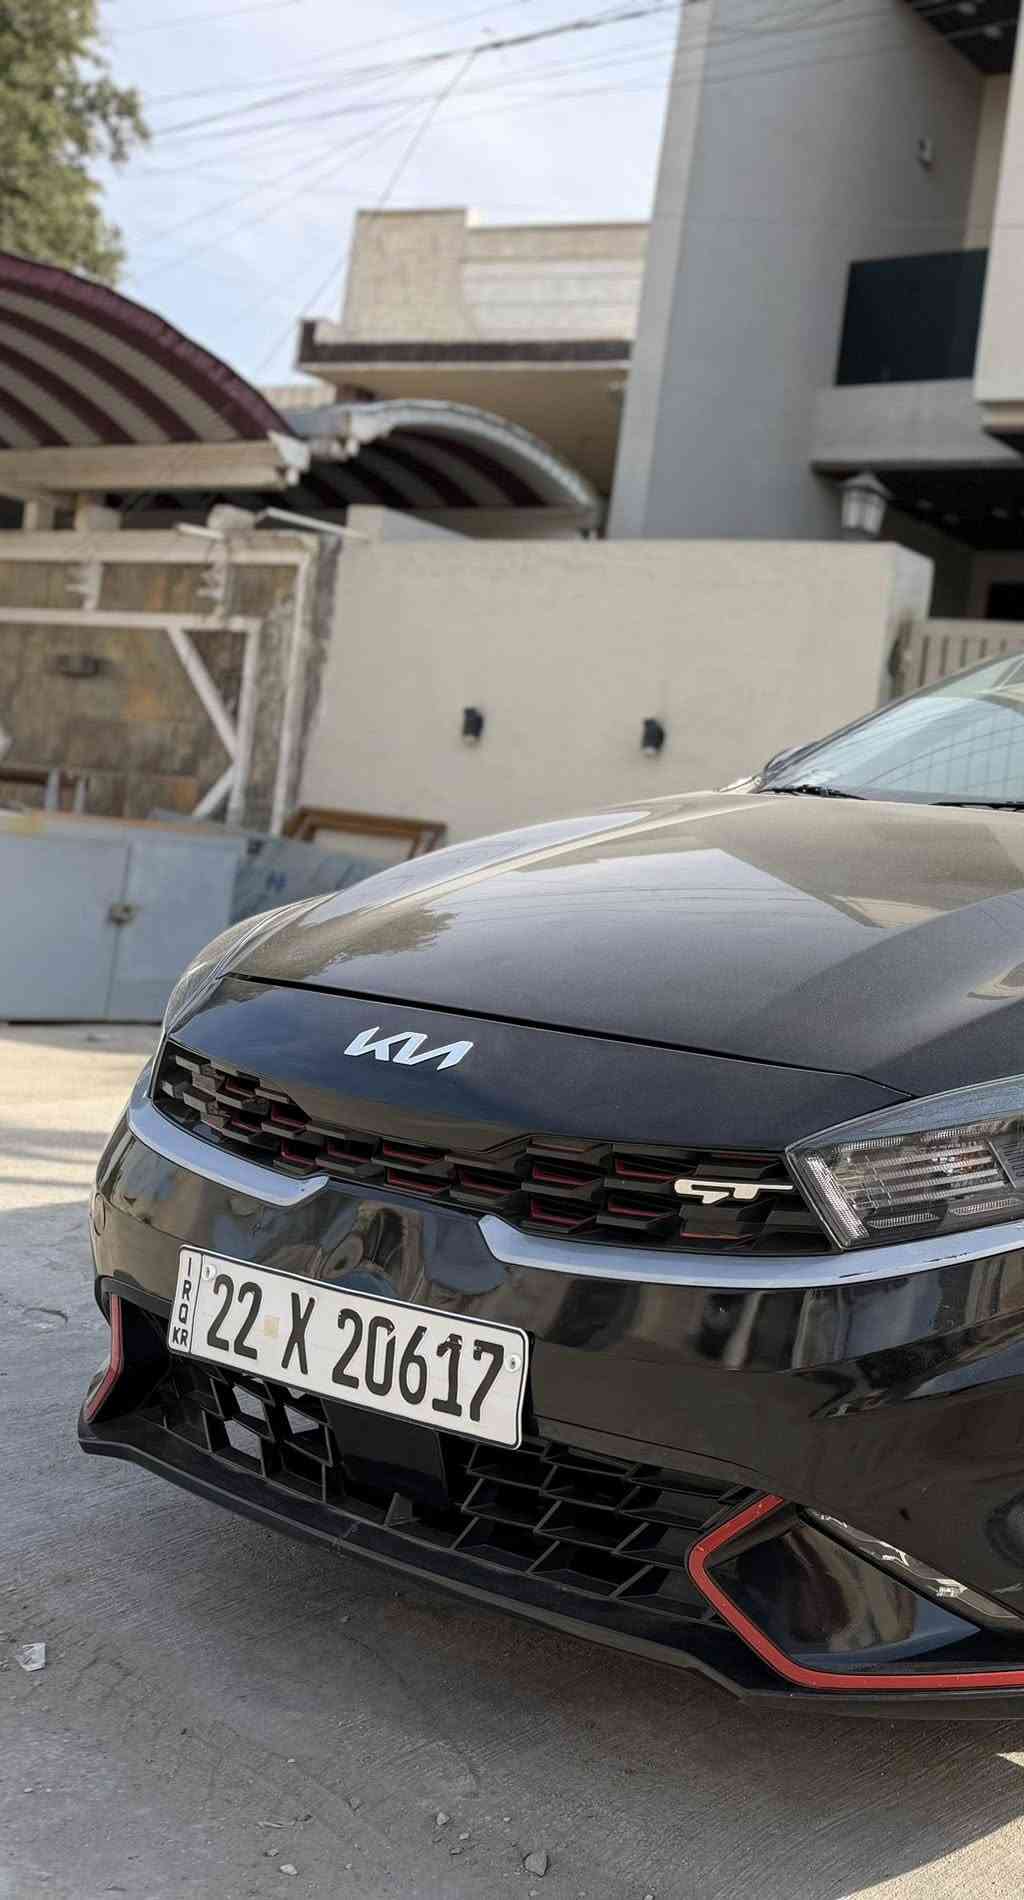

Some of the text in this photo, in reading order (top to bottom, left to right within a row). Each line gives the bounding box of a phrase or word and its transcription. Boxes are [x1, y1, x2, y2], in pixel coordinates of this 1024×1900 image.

[343, 1026, 474, 1071] KIA
[207, 1274, 504, 1422] 22 X 20617
